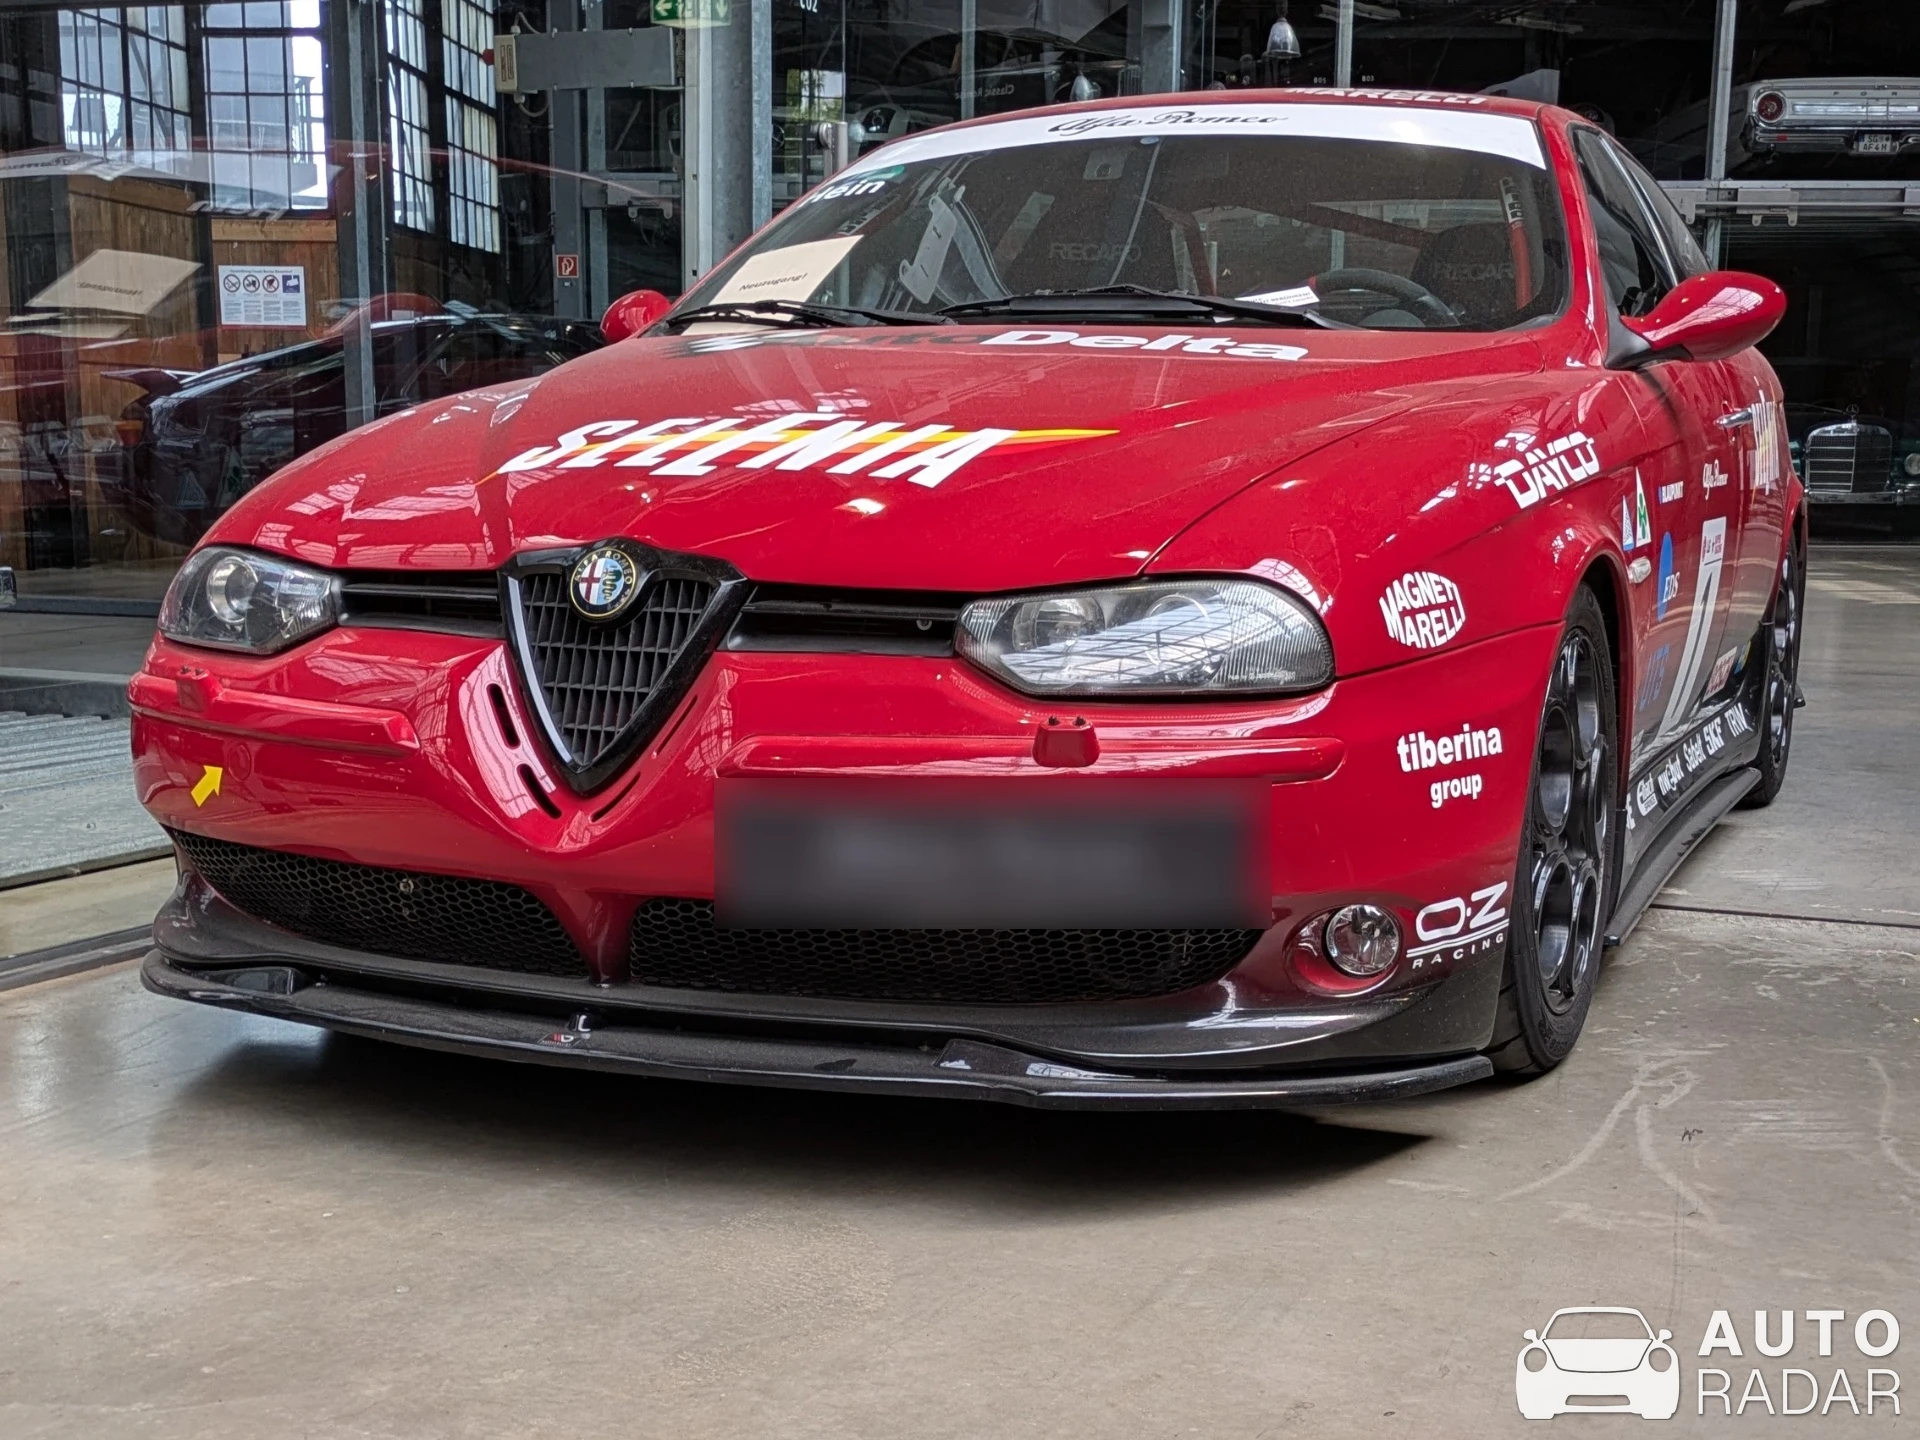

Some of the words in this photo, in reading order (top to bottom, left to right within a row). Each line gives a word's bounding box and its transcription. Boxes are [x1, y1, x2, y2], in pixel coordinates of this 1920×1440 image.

[1048, 114, 1142, 137] Alfa
[1144, 110, 1290, 126] Romeo
[738, 272, 809, 292] Neuzugang!
[498, 412, 1018, 488] SELENIA
[1494, 431, 1600, 509] DAYCO
[574, 553, 600, 583] ALFA
[604, 550, 634, 585] ROMEO
[1662, 571, 1681, 603] EDS
[1397, 723, 1503, 772] tiberina
[1703, 716, 1725, 755] SKF
[1430, 774, 1483, 809] group
[1411, 933, 1505, 970] RACING
